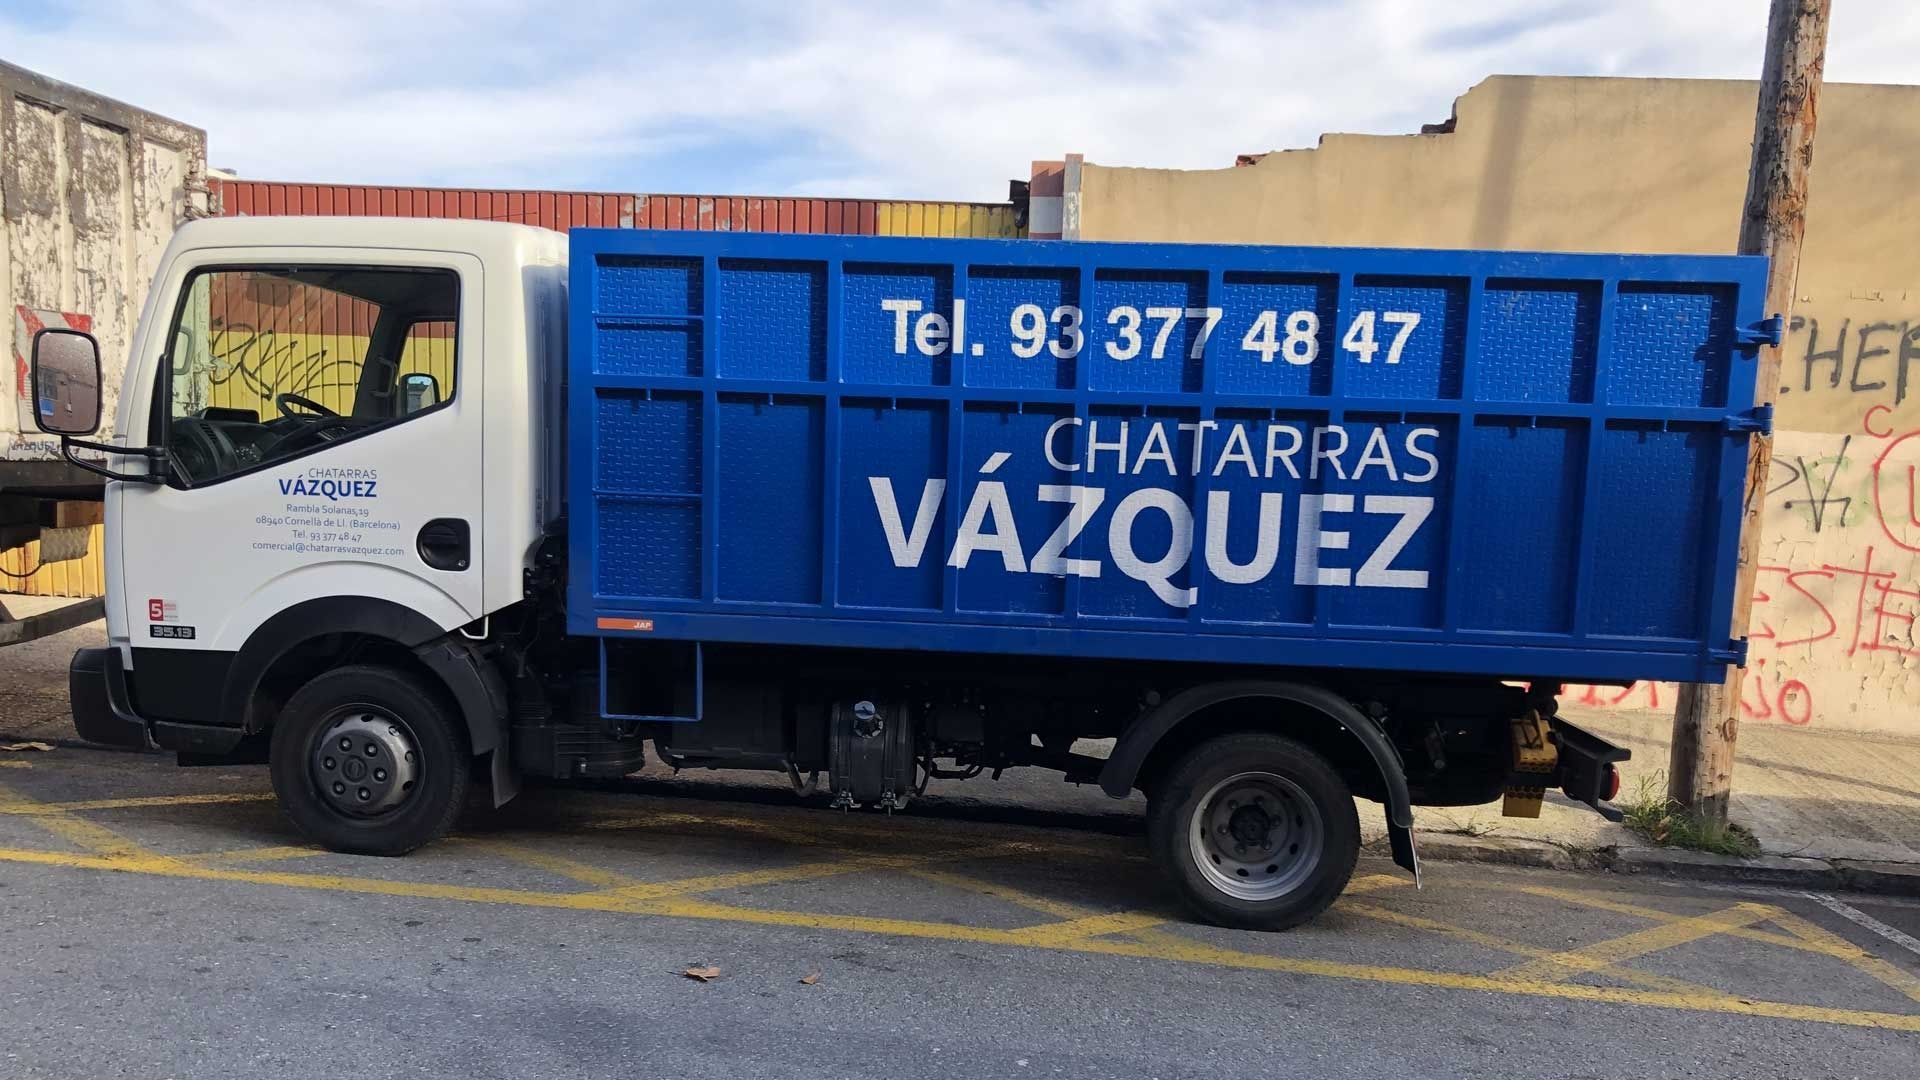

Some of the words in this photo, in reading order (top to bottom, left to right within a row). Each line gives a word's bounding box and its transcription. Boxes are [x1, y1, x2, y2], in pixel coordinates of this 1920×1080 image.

[882, 298, 984, 357] Tel.
[1009, 303, 1085, 359] 93
[1104, 305, 1224, 362] 377
[1242, 309, 1320, 365] 48
[1341, 310, 1421, 365] 47
[1043, 416, 1440, 483] CHATARRAS
[308, 468, 377, 479] CHATARRAS
[279, 475, 377, 500] VÁZQUEZ
[286, 503, 320, 513] Rambla
[256, 515, 283, 526] 08940
[285, 516, 322, 526] Cornellà
[323, 518, 335, 527] de
[349, 520, 400, 531] (Barcelona)
[868, 452, 1436, 608] VÁZQUEZ
[291, 529, 308, 539] Tel.
[310, 532, 321, 541] 93
[322, 533, 337, 543] 377
[338, 531, 350, 542] 48
[351, 534, 362, 543] 47
[252, 542, 404, 556] comercial@chatarrasvazquez.com
[151, 603, 162, 618] 5
[153, 626, 192, 638] 35.13
[633, 621, 651, 629] JAP
